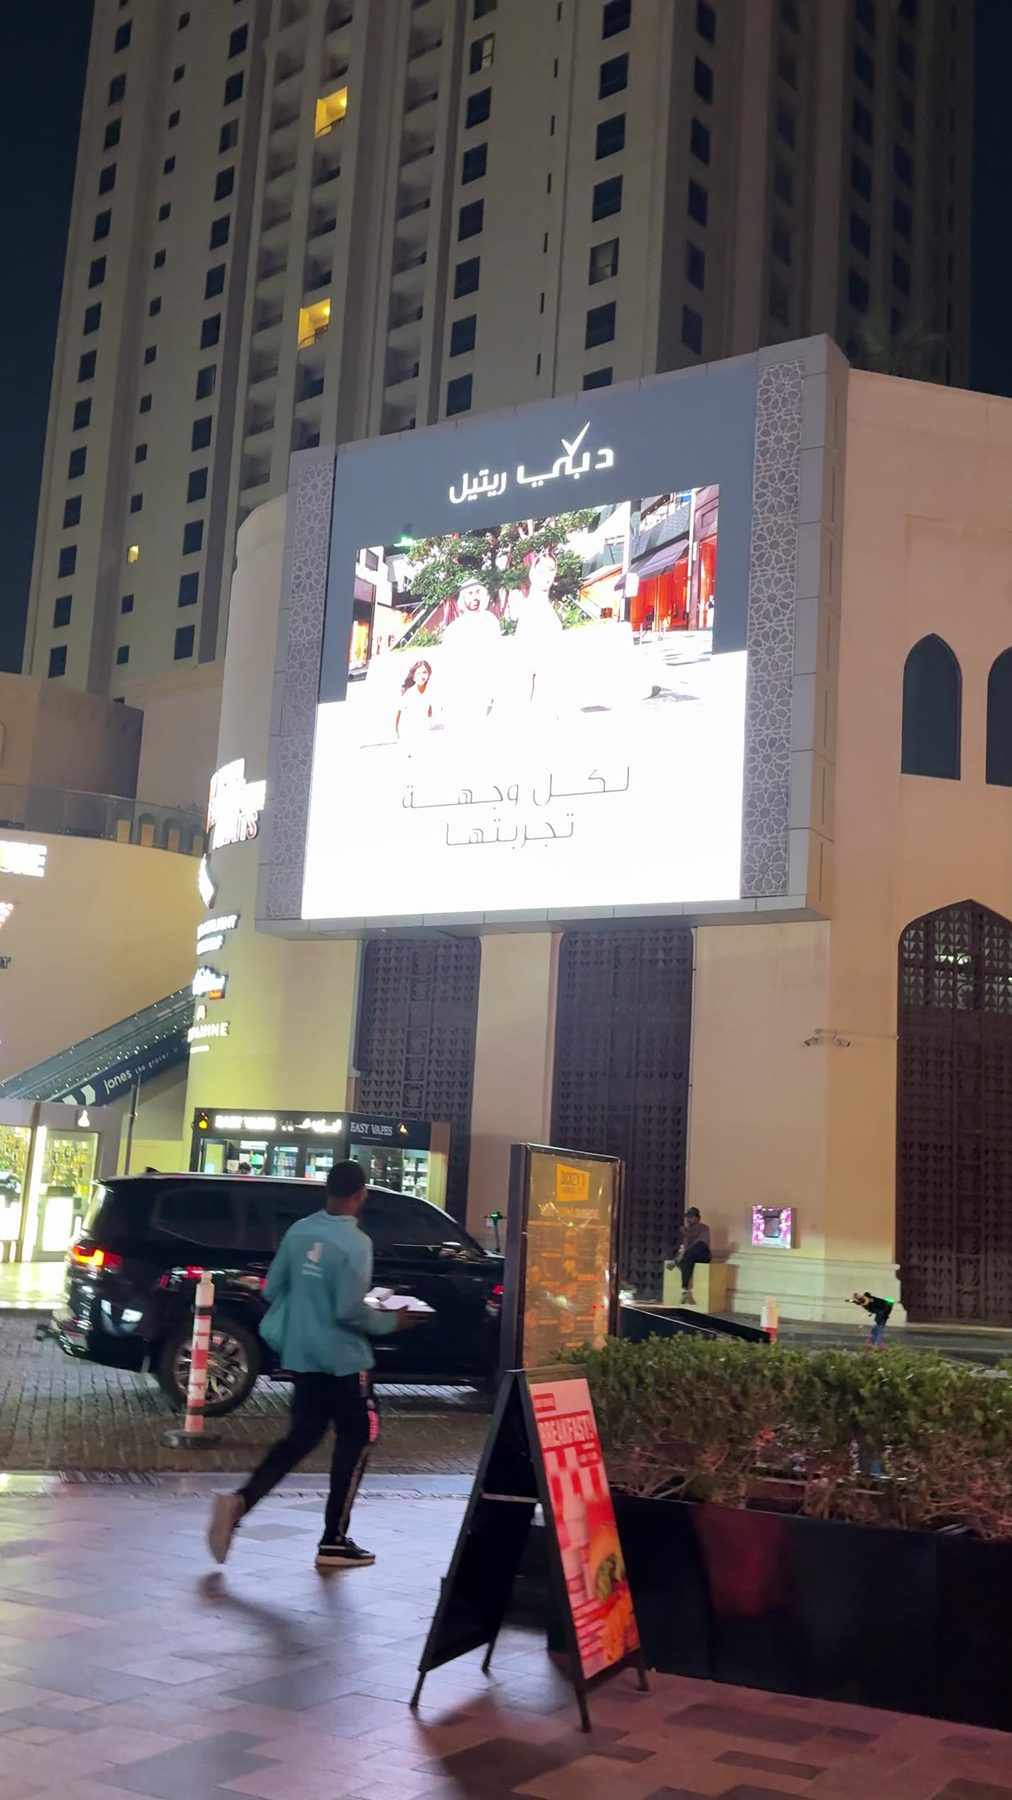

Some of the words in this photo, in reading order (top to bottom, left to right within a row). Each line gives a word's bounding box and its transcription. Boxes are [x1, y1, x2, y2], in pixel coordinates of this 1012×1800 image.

[516, 421, 614, 488] دبي
[448, 468, 507, 504] ريتيل
[446, 812, 575, 850] تجربتها
[350, 1121, 370, 1134] EASY
[370, 1124, 393, 1136] VAPES
